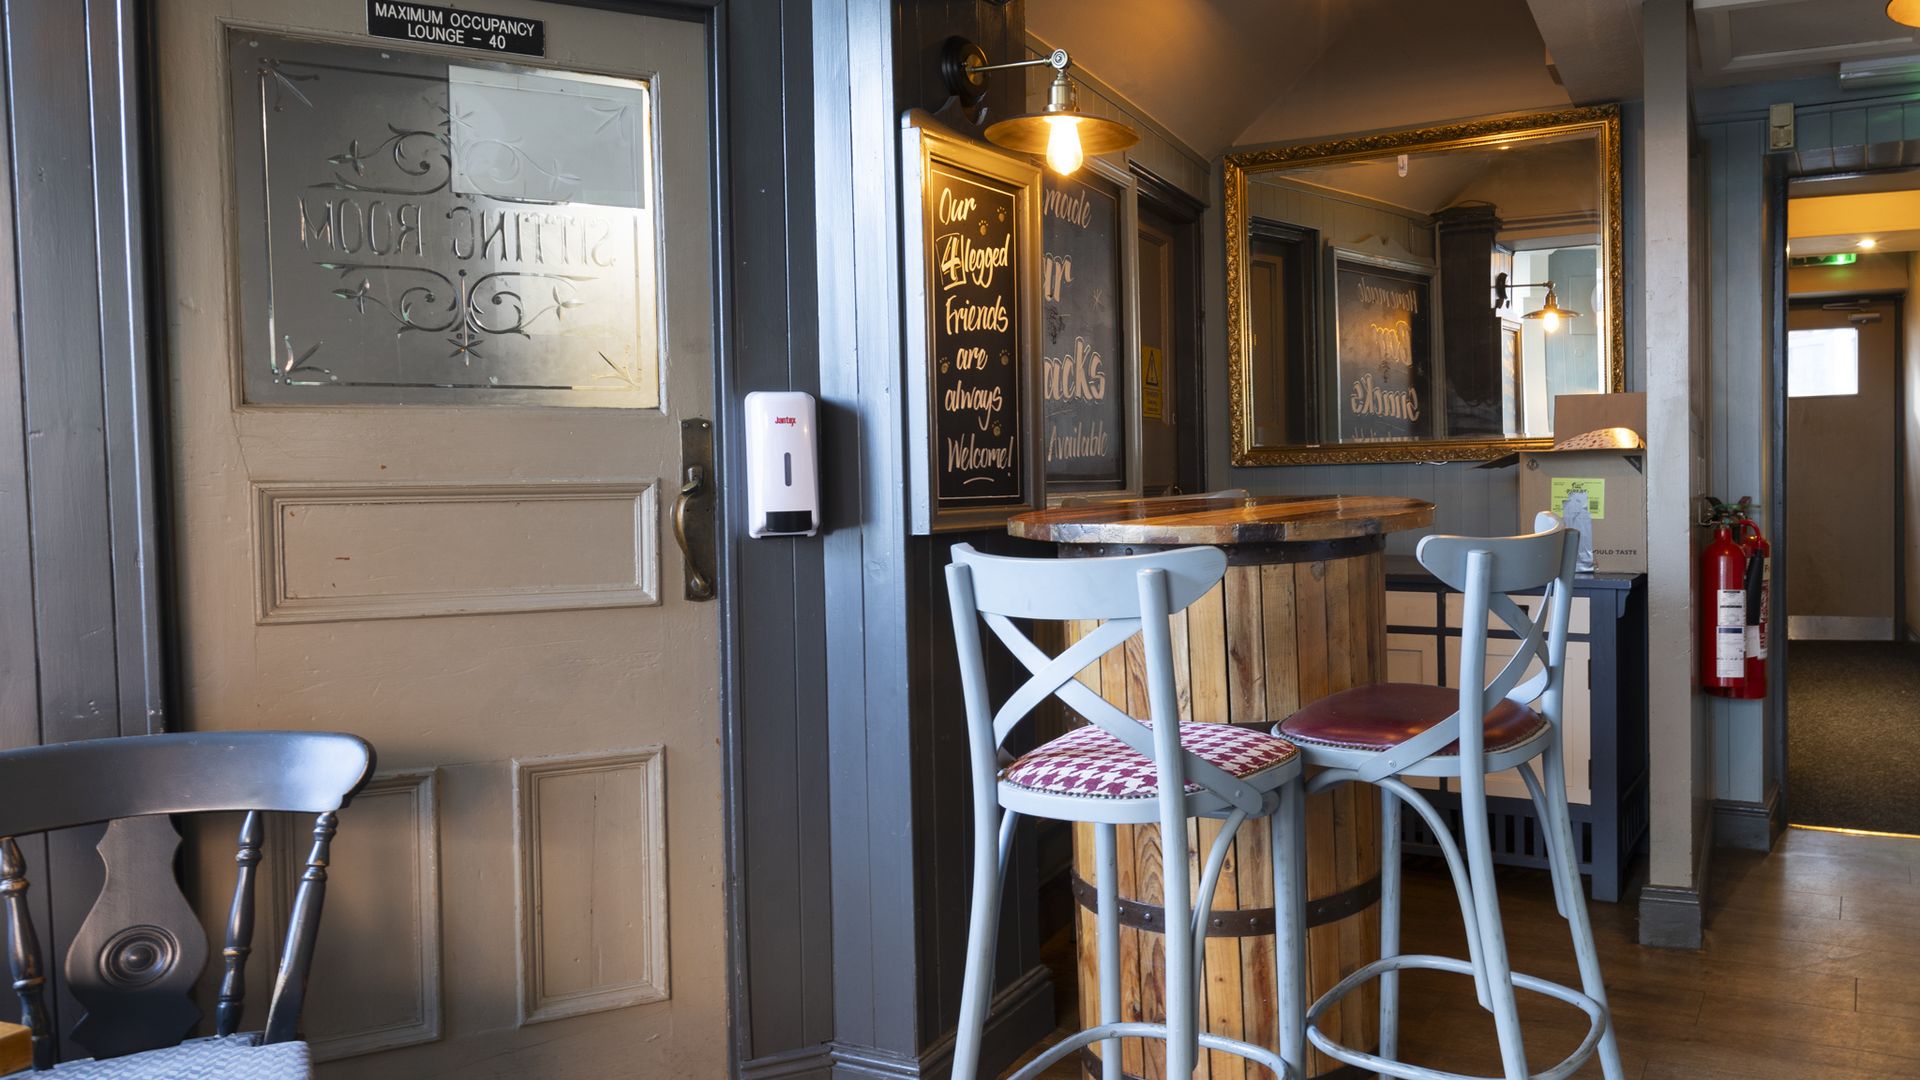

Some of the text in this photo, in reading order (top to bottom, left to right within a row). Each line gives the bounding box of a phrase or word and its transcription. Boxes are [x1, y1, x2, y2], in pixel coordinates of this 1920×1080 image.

[375, 2, 535, 37] MAXIMUM OCCUPANCY
[408, 23, 465, 44] LOUNGE
[489, 35, 506, 49] 40
[940, 187, 977, 226] Our
[945, 294, 1009, 335] Friends
[956, 346, 988, 371] are
[945, 380, 1003, 431] always
[947, 434, 1014, 477] Welcome!
[1047, 421, 1107, 462] Available
